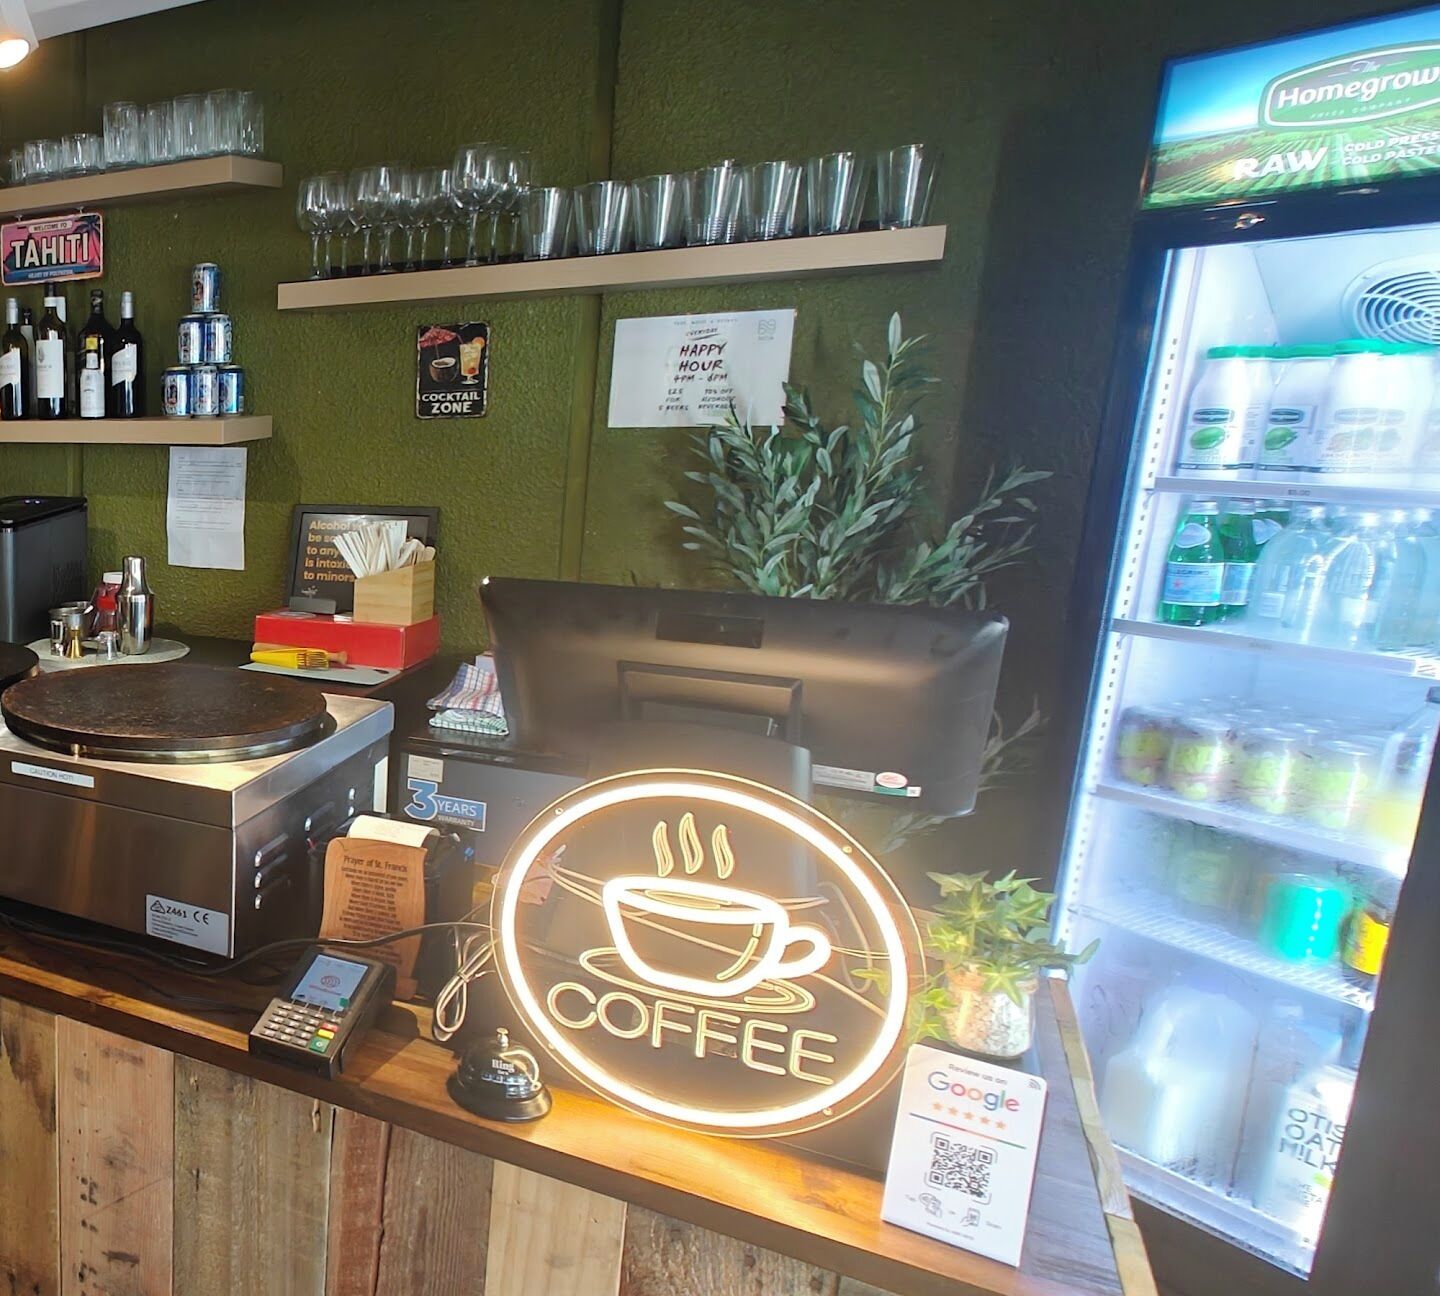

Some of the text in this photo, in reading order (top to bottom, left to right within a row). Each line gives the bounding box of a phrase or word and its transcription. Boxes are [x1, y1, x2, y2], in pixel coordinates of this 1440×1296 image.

[1277, 66, 1440, 109] Homegrow
[1345, 131, 1440, 152] COLD PRESS
[1233, 146, 1328, 181] RAW
[1343, 144, 1440, 166] COLD PASTE
[33, 224, 59, 232] WELCOME
[10, 232, 90, 268] TAHITI
[679, 341, 729, 357] HAPPY
[678, 359, 724, 373] HOUR
[421, 391, 481, 402] COCKTAIL
[431, 401, 472, 414] ZONE
[309, 521, 351, 530] Alcohol
[308, 533, 322, 543] be
[306, 546, 339, 558] to any
[305, 558, 351, 569] is intoxic
[303, 571, 356, 582] to minors
[404, 778, 477, 821] 3 YEARS
[343, 855, 364, 867] Prayer
[366, 859, 375, 867] of
[384, 861, 408, 873] Francis
[546, 981, 838, 1086] COFFEE
[491, 1059, 515, 1073] Ring
[948, 1063, 980, 1077] Review
[981, 1074, 993, 1082] us
[927, 1070, 1020, 1112] Google
[1288, 1108, 1346, 1140] OTIS
[1285, 1124, 1343, 1155] OAT
